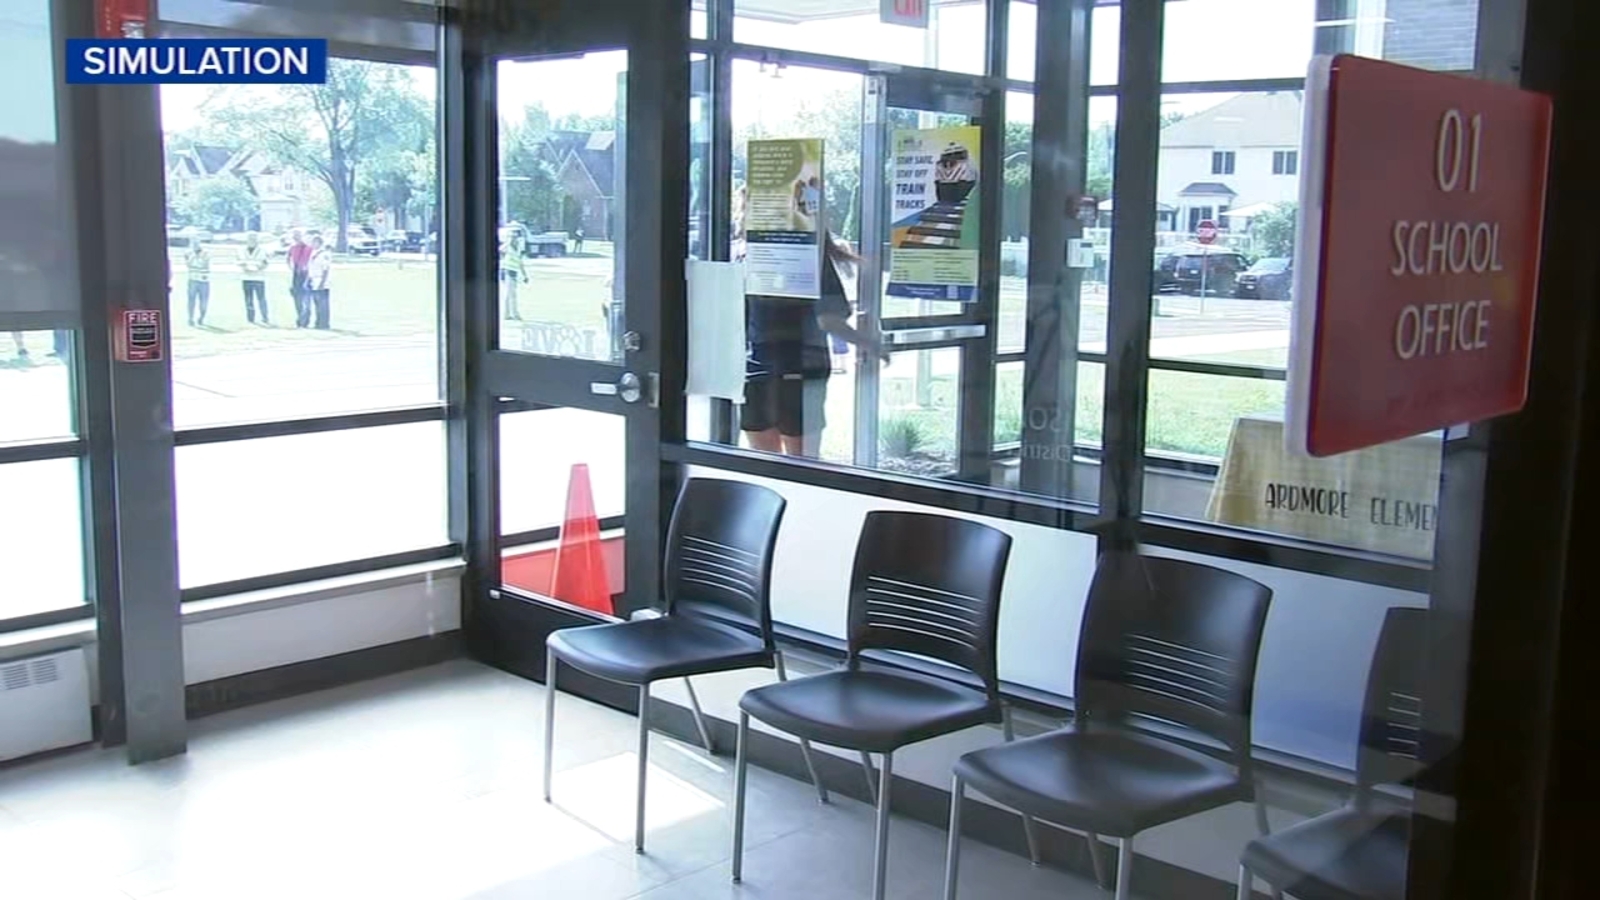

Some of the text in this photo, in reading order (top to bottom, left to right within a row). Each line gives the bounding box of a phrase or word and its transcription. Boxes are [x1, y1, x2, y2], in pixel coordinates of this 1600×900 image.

[896, 156, 913, 165] STAY
[1438, 109, 1481, 192] 01
[896, 183, 926, 195] TRAIN
[896, 199, 925, 209] TRACKS
[1391, 220, 1502, 276] SCHOOL
[129, 313, 157, 324] FIRE
[1395, 300, 1491, 360] OFFICE
[1264, 483, 1349, 519] ARDMORE
